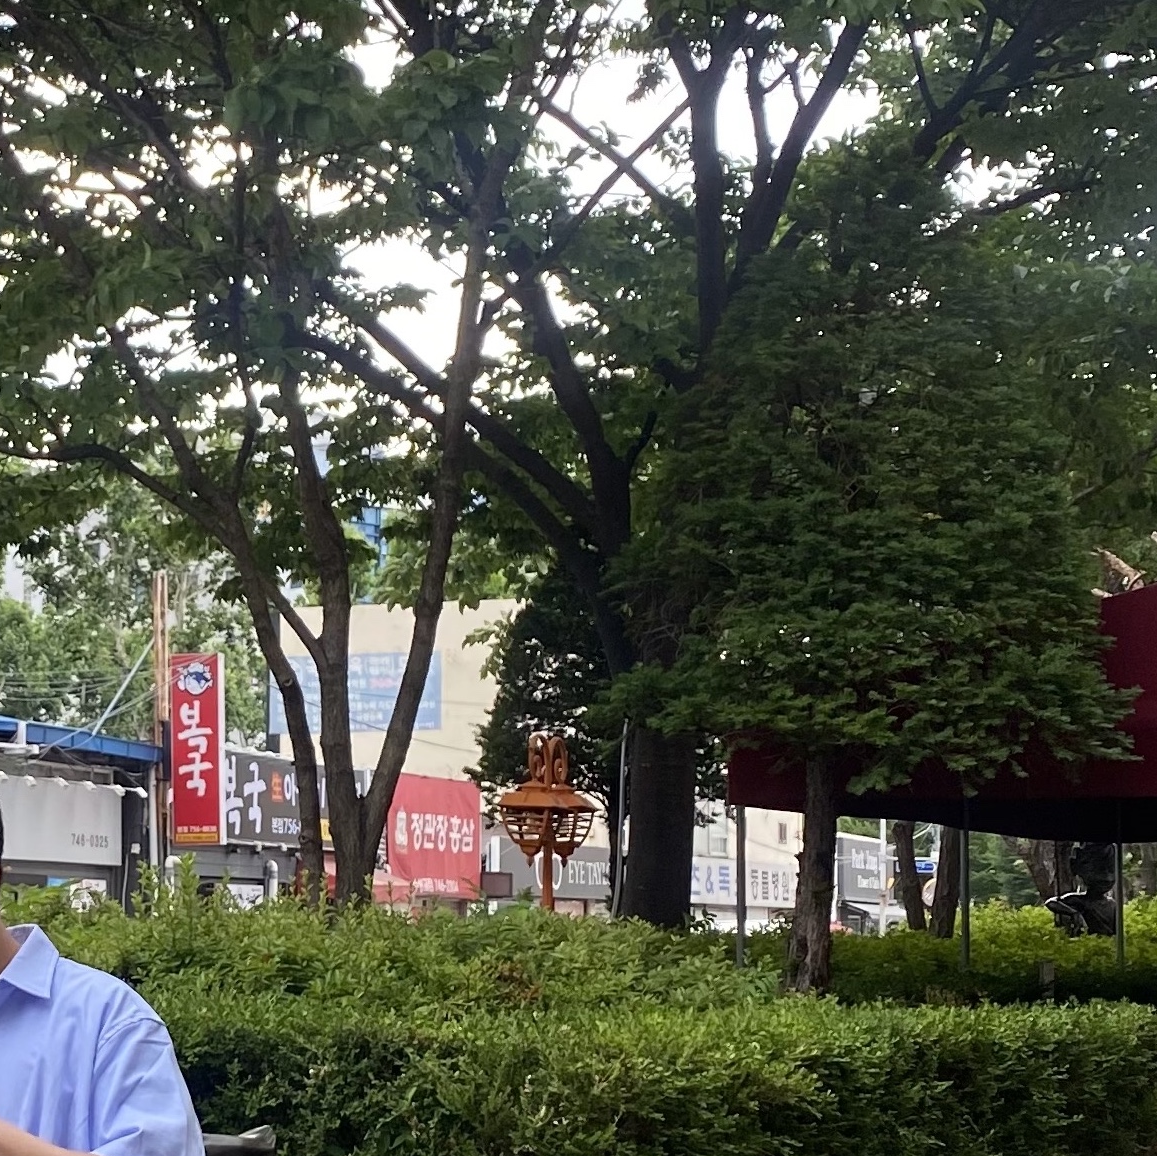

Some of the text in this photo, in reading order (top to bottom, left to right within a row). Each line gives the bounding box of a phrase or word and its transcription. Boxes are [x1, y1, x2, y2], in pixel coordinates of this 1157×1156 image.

[177, 700, 214, 797] 복국
[225, 755, 267, 835] 복국
[568, 860, 586, 884] EYE
